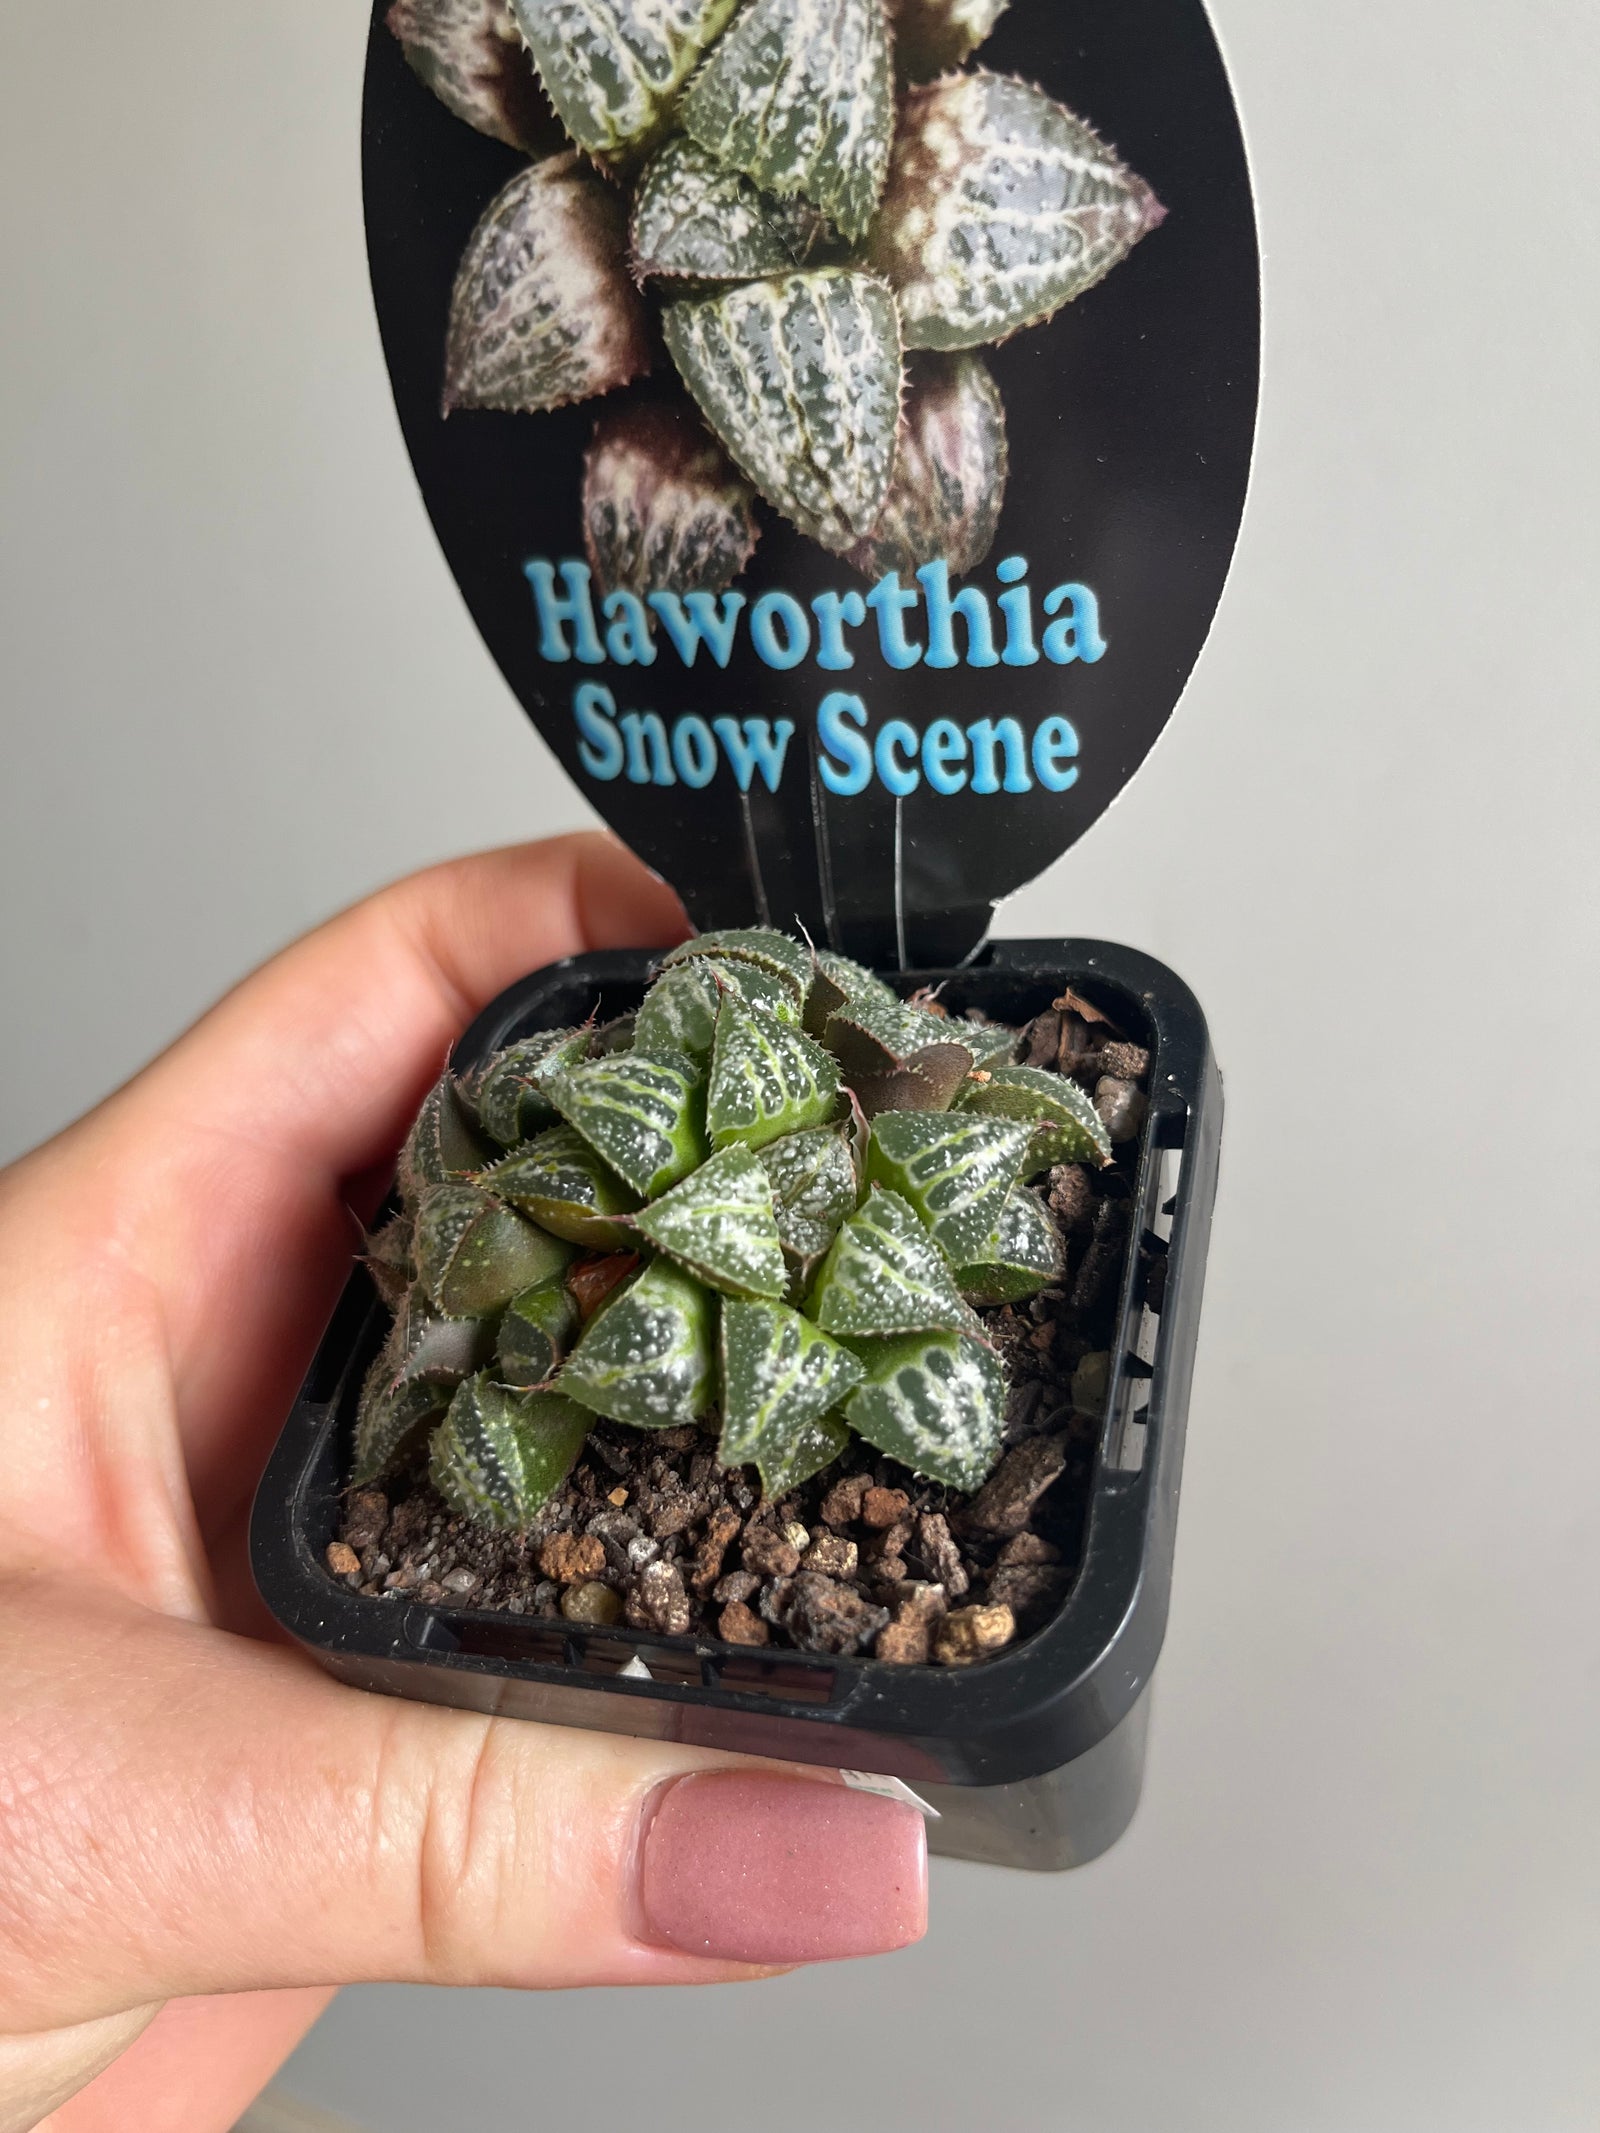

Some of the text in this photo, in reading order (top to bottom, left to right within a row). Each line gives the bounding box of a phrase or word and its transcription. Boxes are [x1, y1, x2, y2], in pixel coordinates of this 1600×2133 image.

[523, 556, 1106, 671] Haworthia
[573, 682, 1079, 797] Snow Scene
